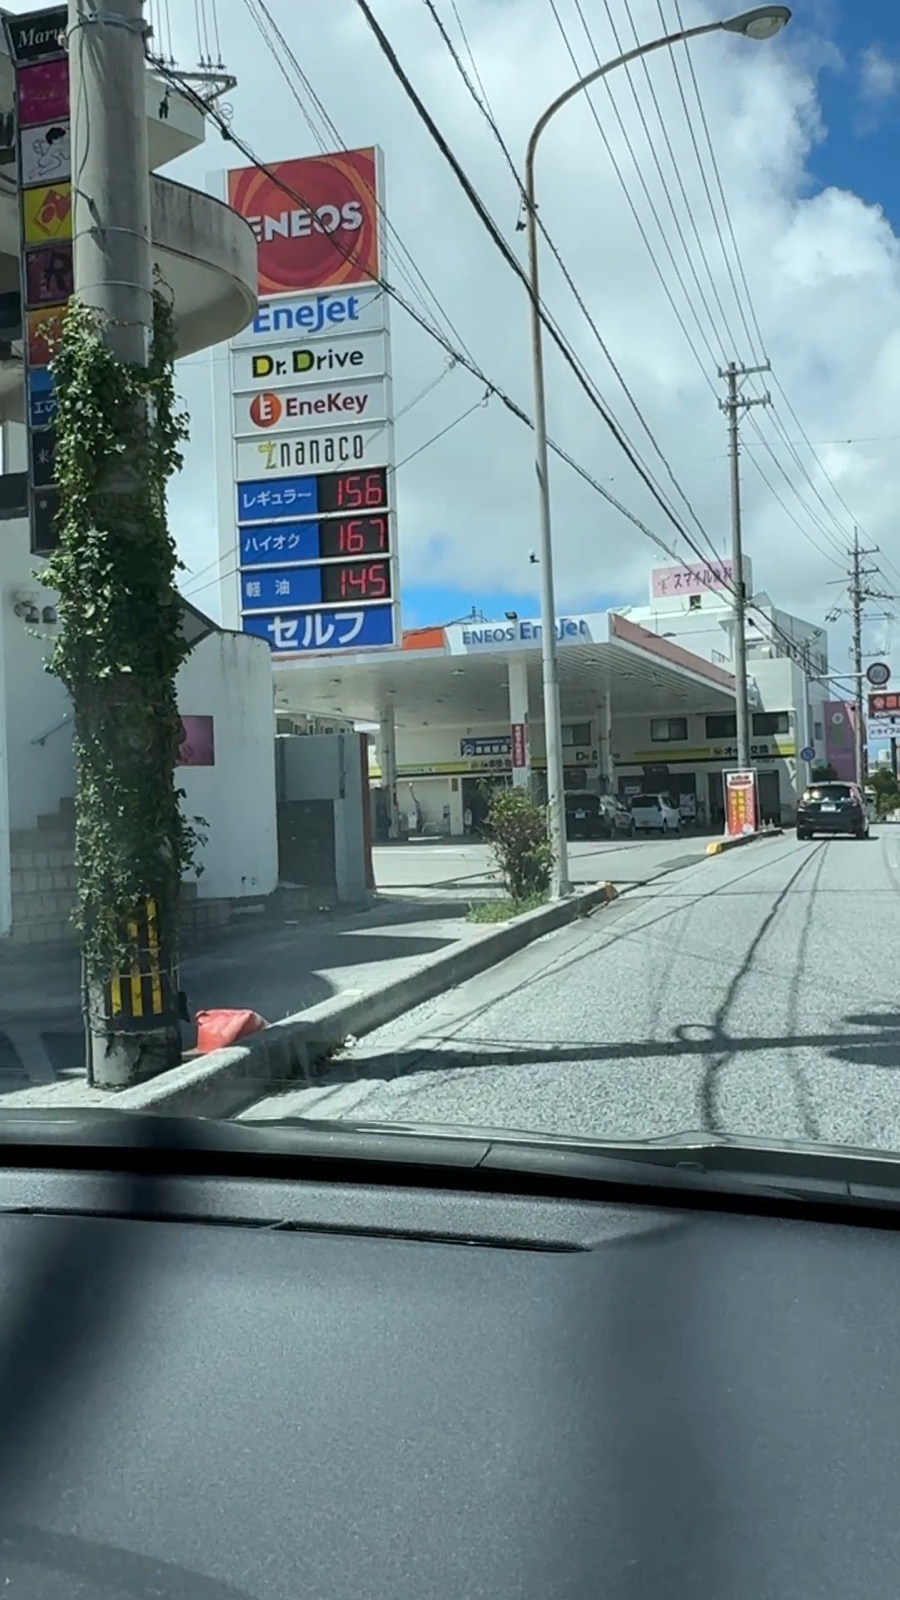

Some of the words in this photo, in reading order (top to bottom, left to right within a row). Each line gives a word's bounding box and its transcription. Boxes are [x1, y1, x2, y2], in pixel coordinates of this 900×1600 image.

[247, 201, 363, 243] ENEOS
[286, 392, 368, 417] EneKey
[280, 434, 364, 468] nanaco
[243, 488, 312, 509] レギュラー
[337, 474, 383, 507] 156
[245, 533, 301, 552] ハイオク
[339, 518, 387, 553] 167
[340, 564, 387, 597] 145
[267, 611, 365, 648] セルフ
[462, 628, 515, 645] ENEOS
